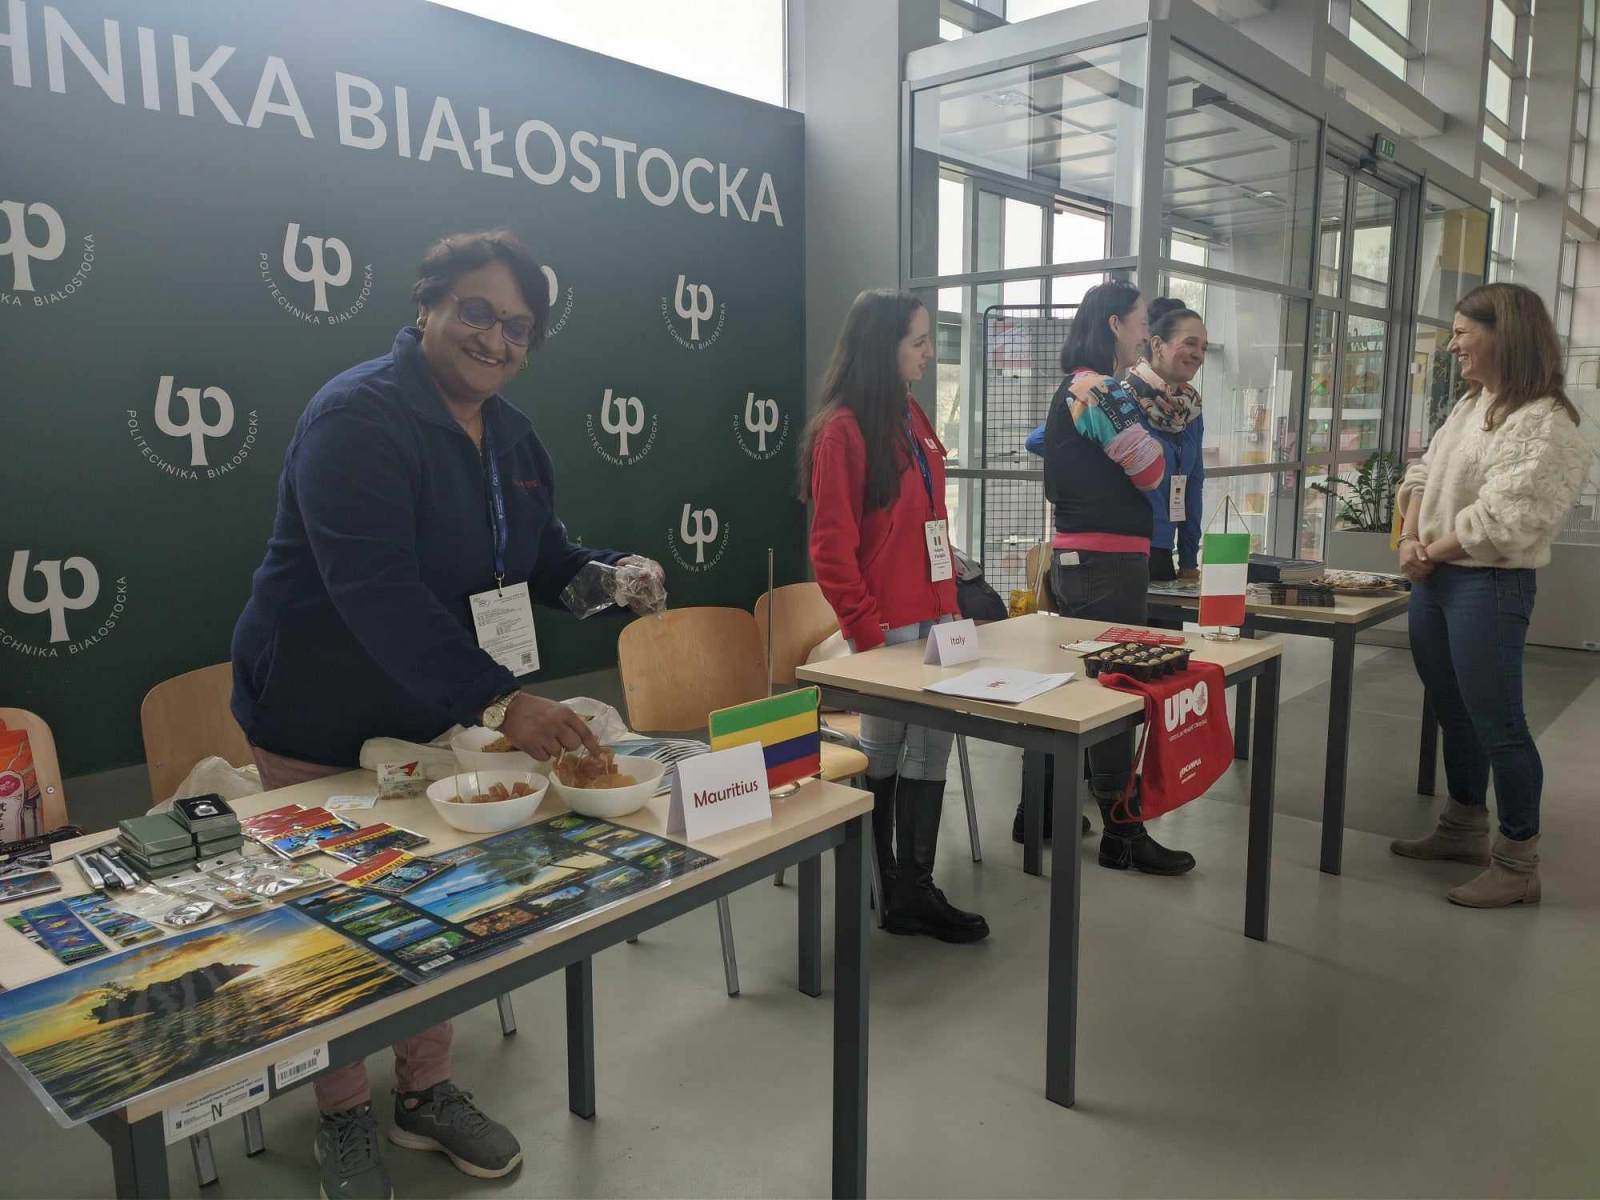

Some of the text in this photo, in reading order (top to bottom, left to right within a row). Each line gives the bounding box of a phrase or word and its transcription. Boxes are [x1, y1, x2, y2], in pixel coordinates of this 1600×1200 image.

[335, 71, 784, 227] BIAŁOSTOCKA
[33, 233, 95, 307] BIAŁOSTOCKA
[259, 252, 374, 325] POLITECHNIKA BIAŁOSTOCKA
[127, 409, 259, 480] POLITECHNIKA BIAŁOSTOCKA
[586, 413, 623, 465] POLITECHNIKA
[68, 576, 127, 654] BIAŁOSTOCKA
[950, 634, 965, 646] Italy
[1164, 681, 1208, 732] UPO
[693, 779, 759, 809] Mauritius
